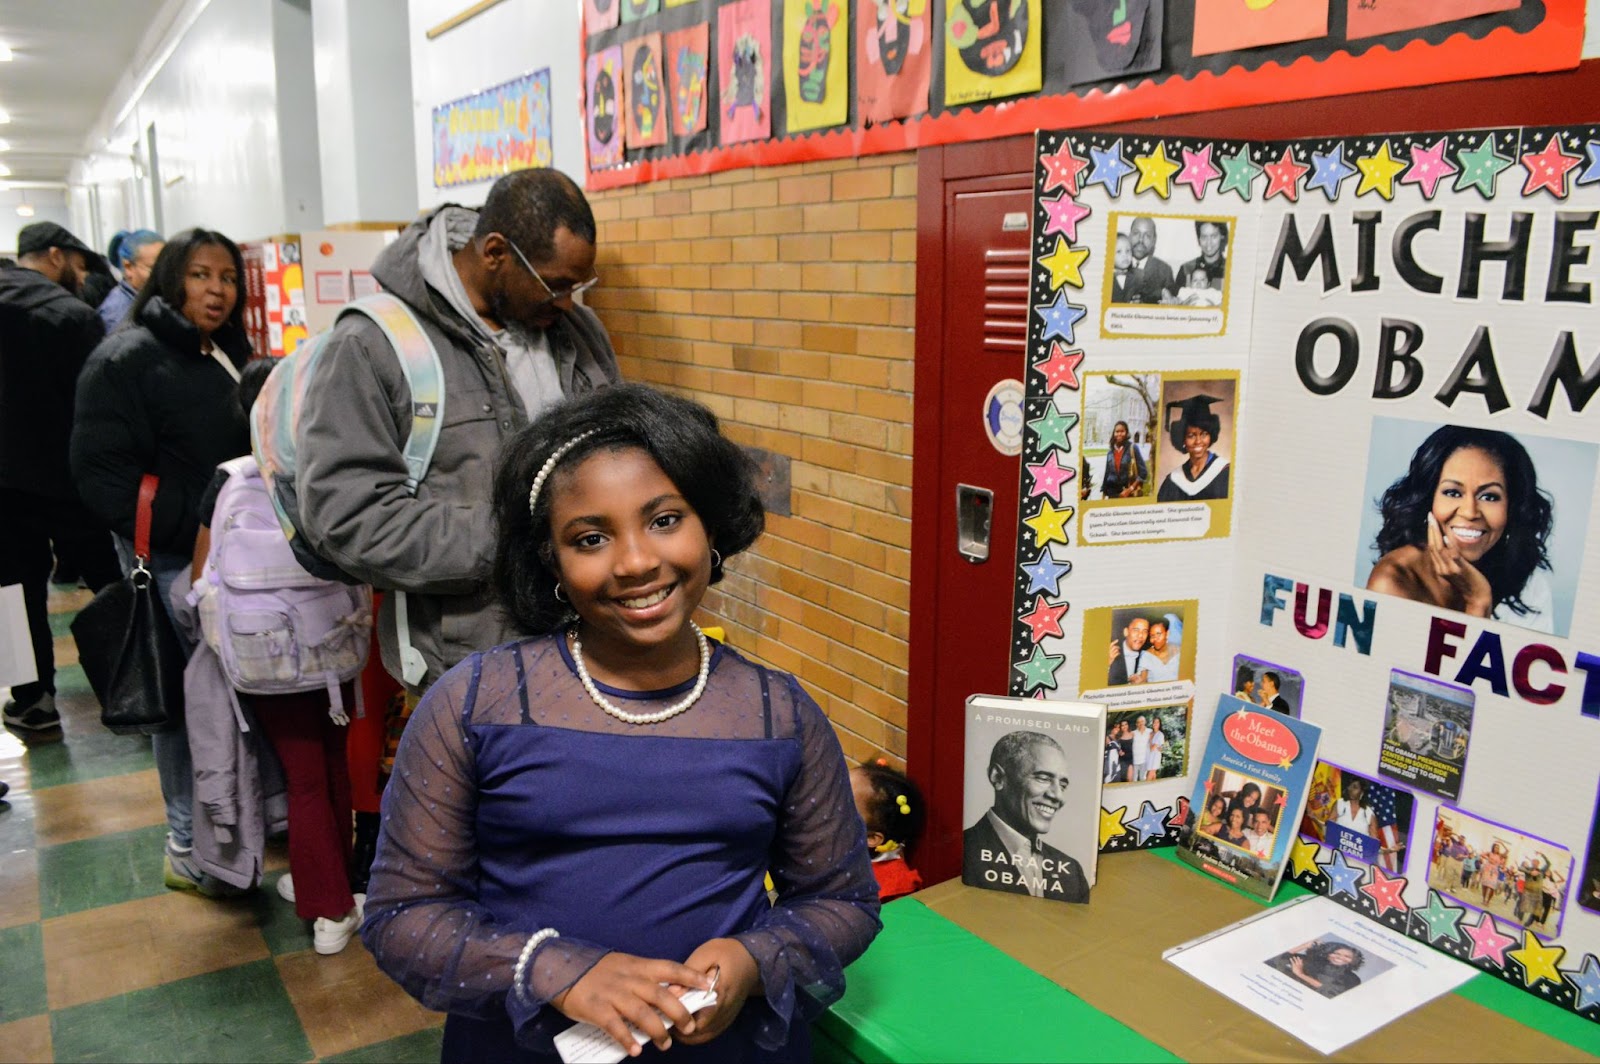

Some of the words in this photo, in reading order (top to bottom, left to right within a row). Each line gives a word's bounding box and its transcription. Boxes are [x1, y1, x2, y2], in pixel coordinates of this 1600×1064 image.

[1264, 210, 1600, 304] MICHE
[1295, 317, 1600, 420] OBAM
[1260, 573, 1377, 656] FUN
[975, 713, 982, 721] A
[986, 714, 1051, 729] PROMISED
[1056, 722, 1090, 734] LAND
[1248, 719, 1276, 738] Meet
[1230, 728, 1246, 743] the
[1246, 732, 1288, 757] Obamas
[1221, 754, 1247, 770] America's
[1247, 763, 1262, 774] First
[1262, 769, 1282, 783] Family
[1380, 762, 1401, 774] SPRING
[1381, 756, 1408, 769] CHICAGO
[1408, 765, 1419, 773] SET
[1420, 769, 1428, 777] TO
[1428, 773, 1446, 783] OPEN
[1382, 750, 1405, 761] CENTER
[1412, 760, 1433, 771] SOUTH
[1433, 767, 1448, 777] SIDE
[1383, 743, 1395, 752] THE
[1395, 747, 1417, 759] OBAMA
[1417, 755, 1460, 775] PRESIDENTIAL
[1339, 838, 1363, 852] GIRLS
[1340, 830, 1354, 840] LET
[980, 849, 1071, 875] BARACK
[1339, 844, 1363, 859] LEARN
[984, 869, 1065, 894] OBAMA
